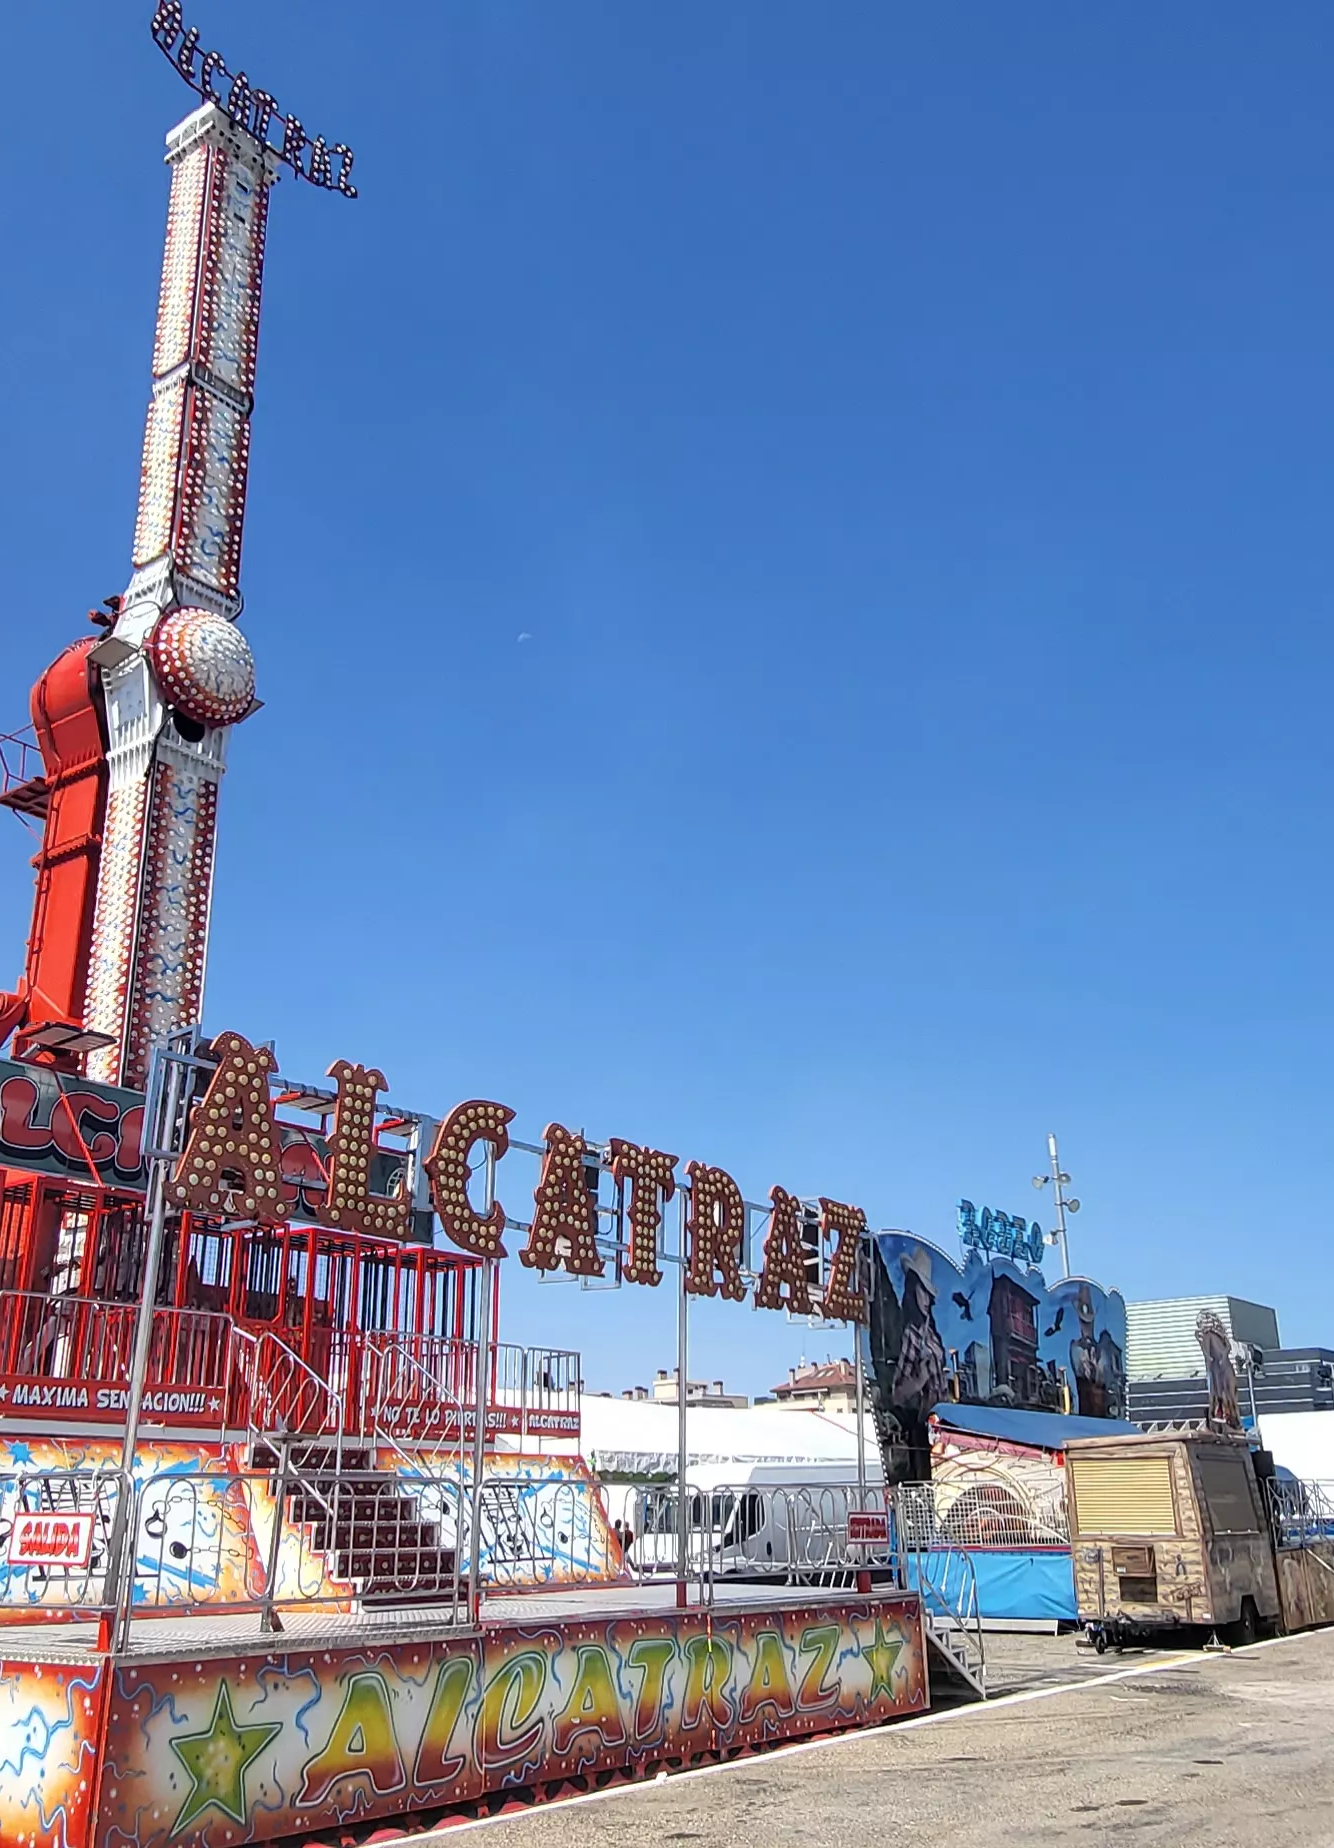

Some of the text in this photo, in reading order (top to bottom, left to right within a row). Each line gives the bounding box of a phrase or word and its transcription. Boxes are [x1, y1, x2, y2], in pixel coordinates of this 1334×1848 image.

[151, 0, 358, 199] ALCATRAZ
[167, 1030, 870, 1328] ALCATRAZ
[12, 1383, 207, 1414] MAXIMA SENACION!!!
[383, 1405, 400, 1423] NO
[528, 1413, 580, 1431] ALCATRAZ
[18, 1520, 81, 1558] SALIDA
[293, 1622, 844, 1810] ALCATRAZ
